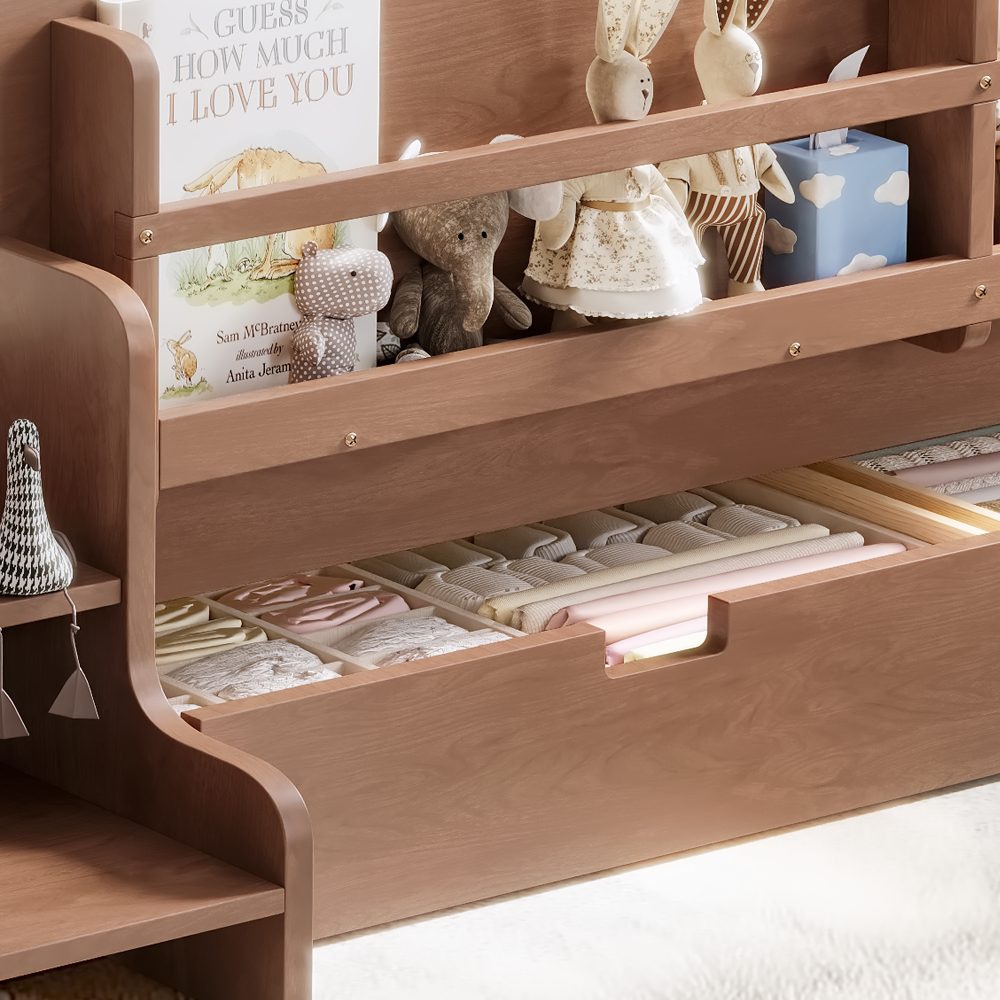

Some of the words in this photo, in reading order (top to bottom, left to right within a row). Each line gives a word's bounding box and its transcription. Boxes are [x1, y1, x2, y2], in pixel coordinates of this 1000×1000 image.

[173, 43, 247, 83] HOW
[256, 26, 349, 69] MUCH
[166, 92, 177, 126] I
[190, 80, 278, 122] LOVE
[285, 63, 355, 106] YOU
[216, 330, 240, 345] Sam
[235, 343, 274, 361] illustrated
[273, 342, 284, 357] by
[226, 367, 256, 384] Anita
[258, 362, 292, 377] Jeram
